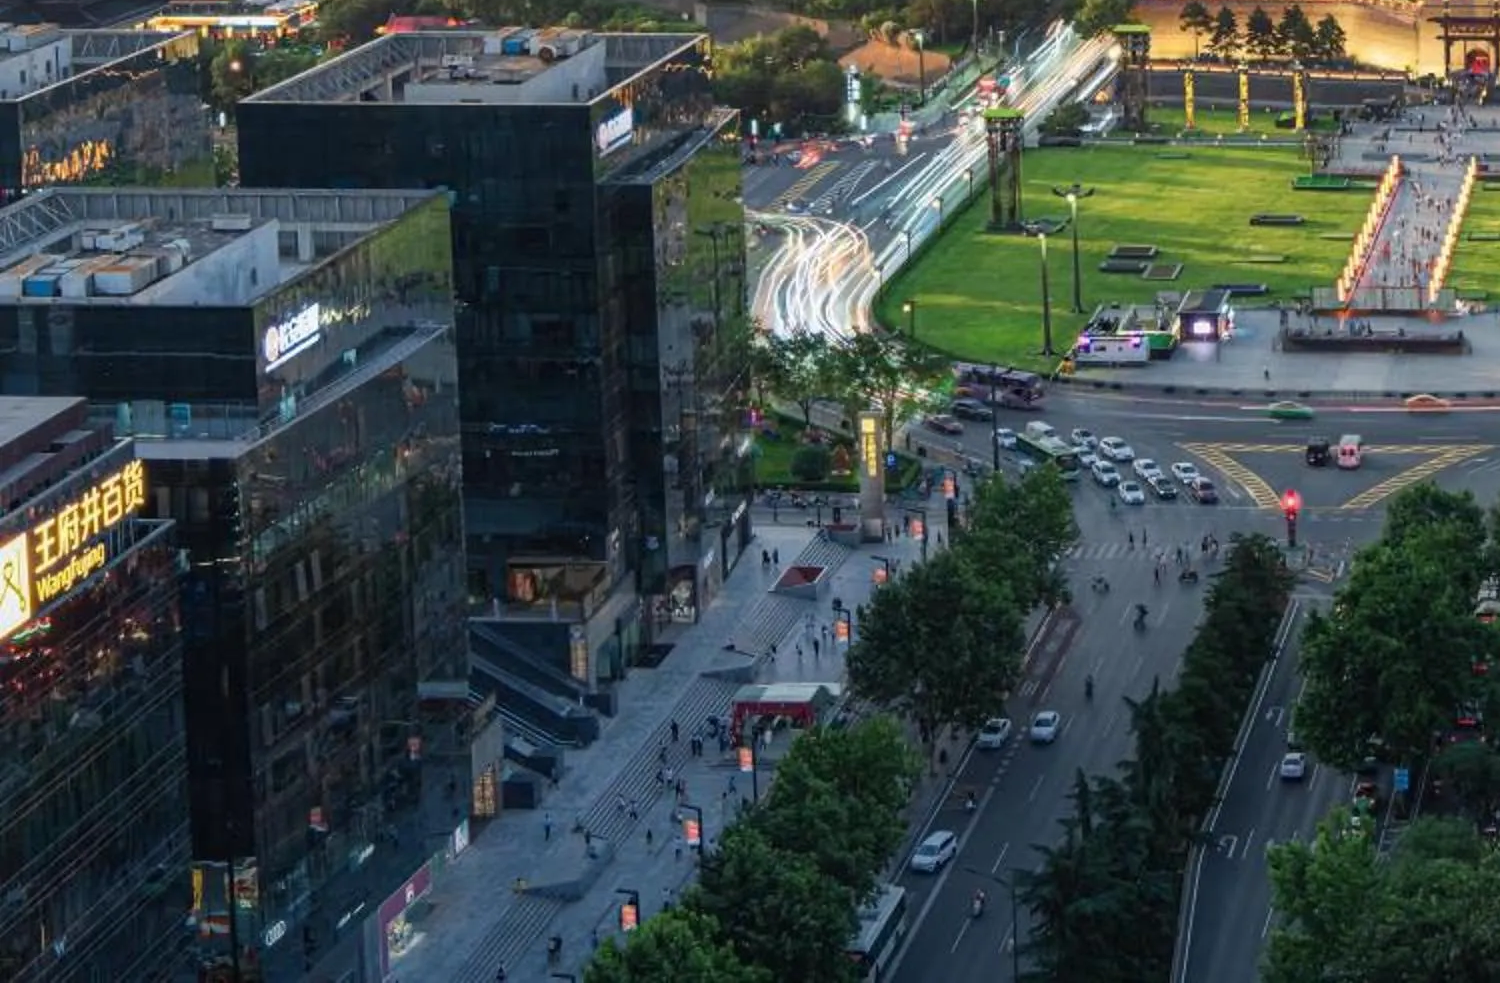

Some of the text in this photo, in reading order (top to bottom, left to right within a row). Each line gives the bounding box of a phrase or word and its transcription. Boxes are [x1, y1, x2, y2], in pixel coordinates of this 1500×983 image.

[35, 458, 144, 573] 王府井百货
[37, 543, 105, 601] Wangfujing
